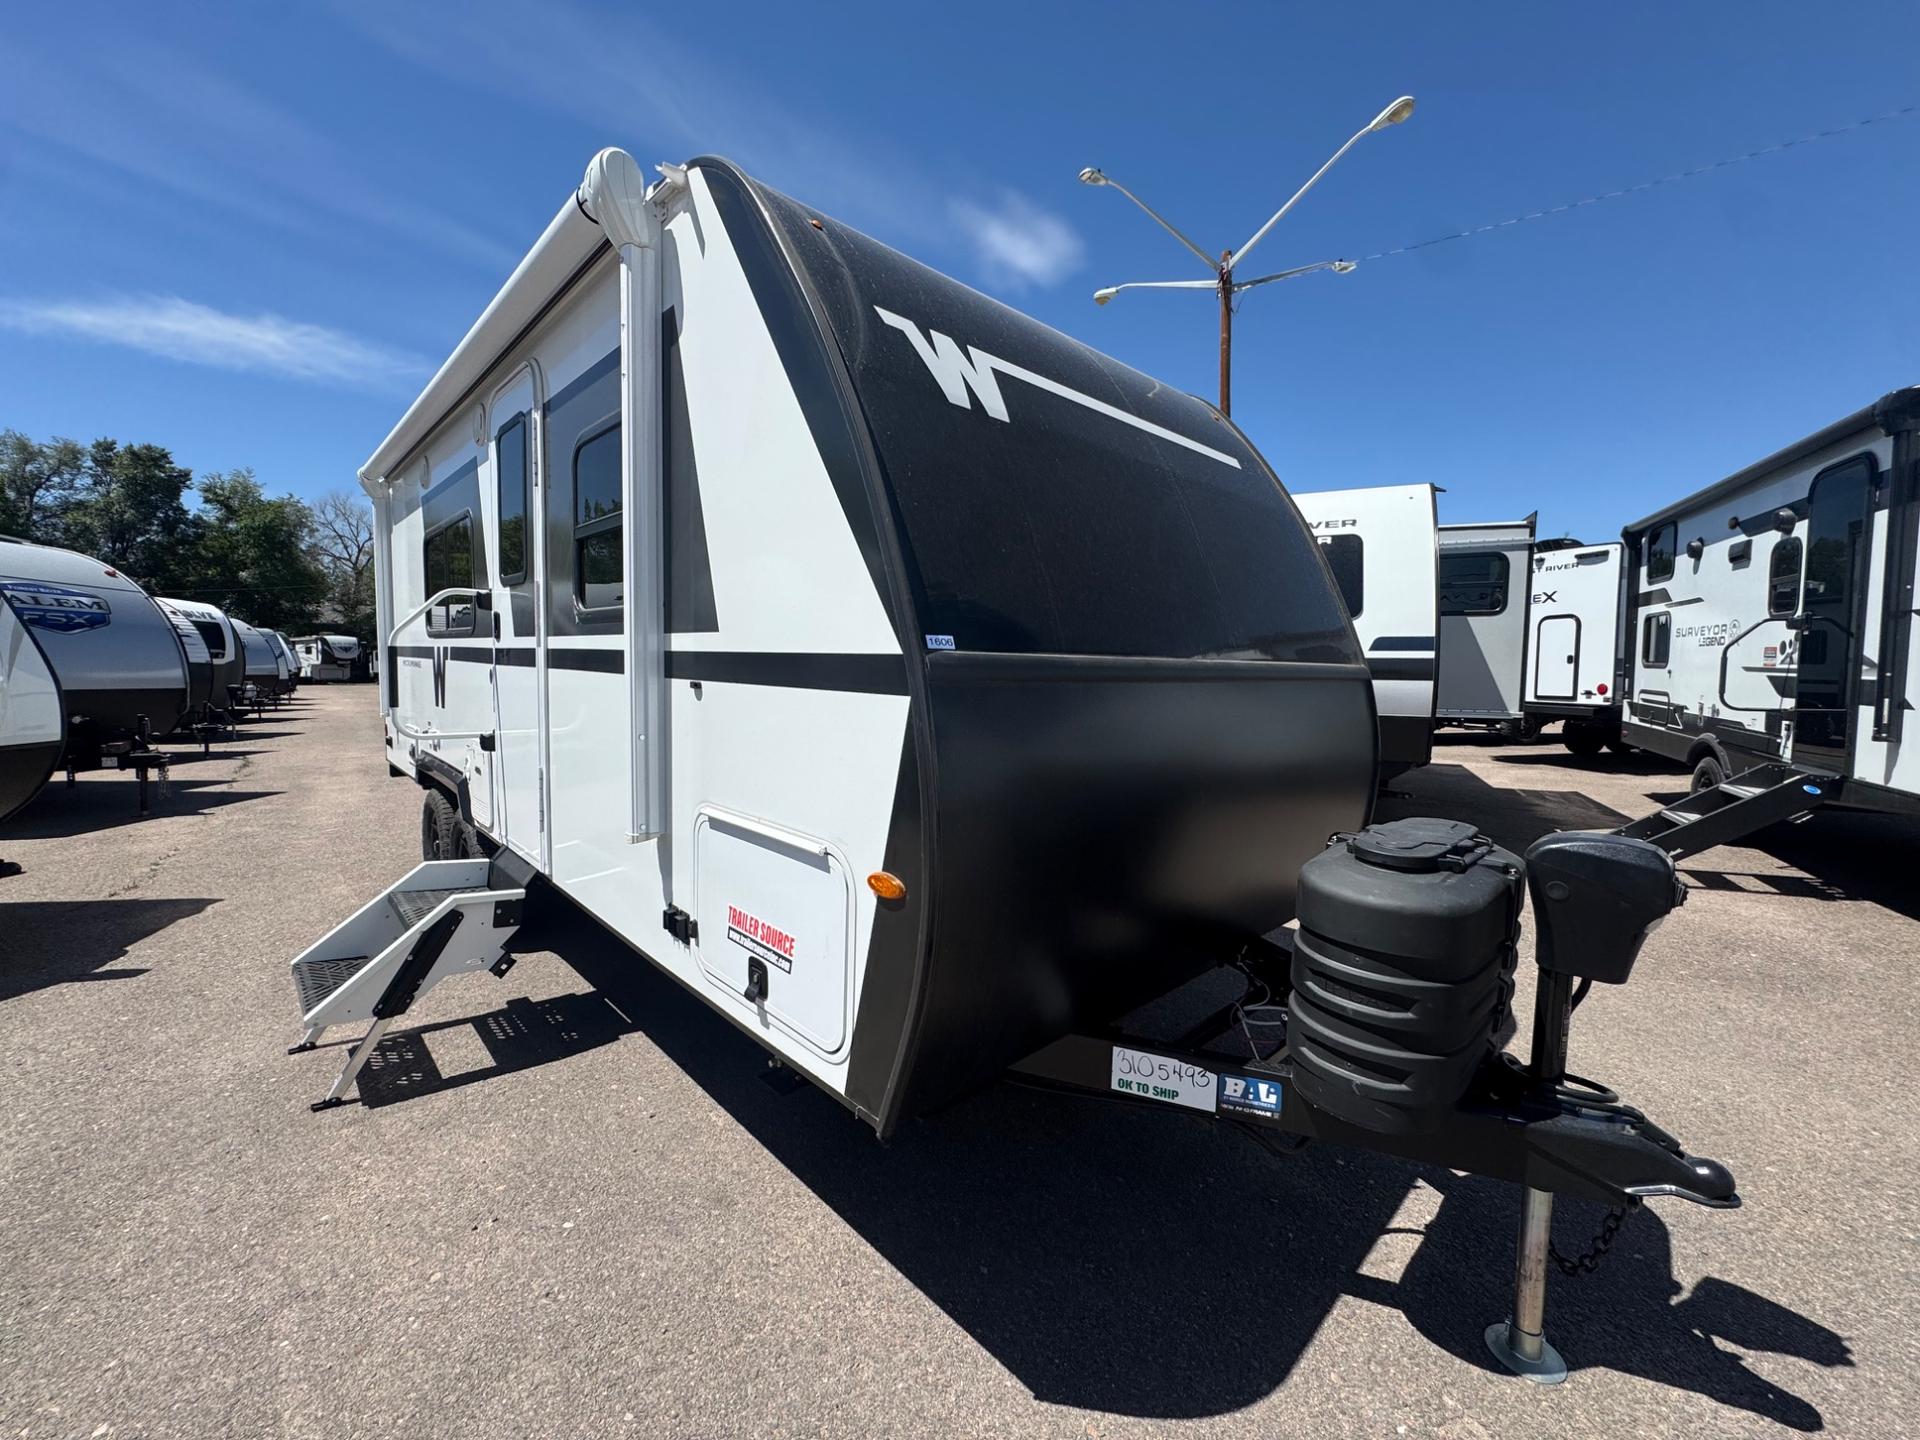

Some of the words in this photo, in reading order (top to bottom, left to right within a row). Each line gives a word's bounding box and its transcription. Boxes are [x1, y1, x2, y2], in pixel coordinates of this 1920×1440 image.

[1307, 519, 1357, 529] VER
[1545, 562, 1579, 572] RIVER
[8, 594, 106, 610] ALEM
[1532, 590, 1558, 604] EX
[23, 611, 93, 624] FSX
[1675, 623, 1728, 638] SURVEYOR
[929, 637, 954, 647] 1606
[1698, 636, 1726, 647] LEGEND
[728, 905, 760, 938] TRAILER
[760, 922, 795, 957] SOURCE
[1118, 1078, 1133, 1091] OK
[1136, 1082, 1150, 1095] TO
[1152, 1086, 1179, 1101] SHIP
